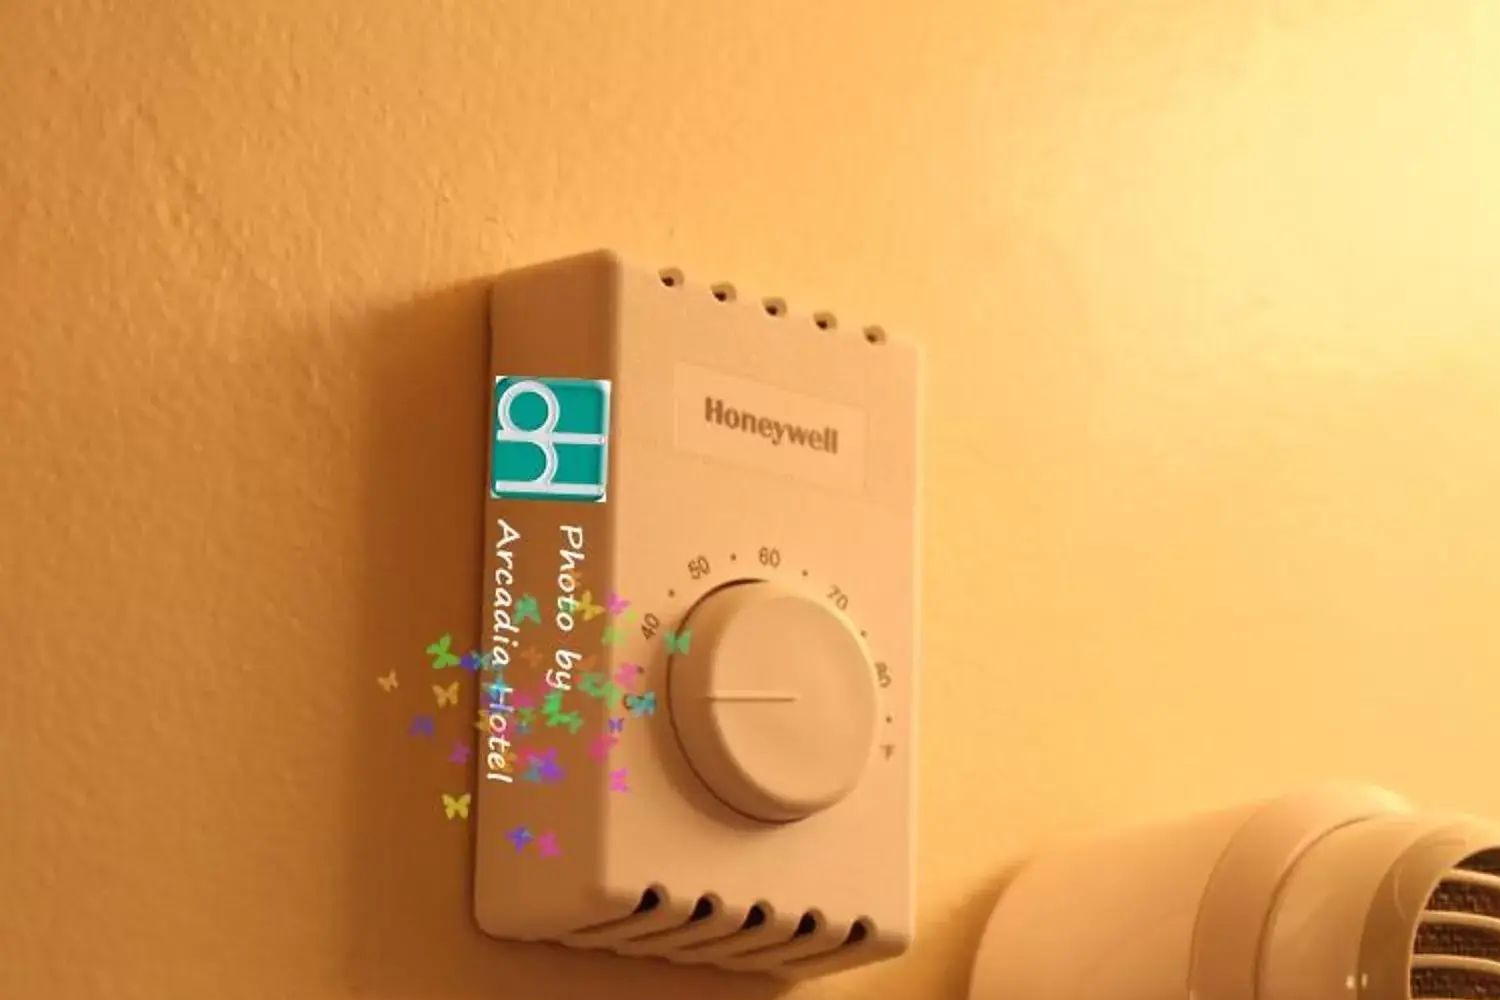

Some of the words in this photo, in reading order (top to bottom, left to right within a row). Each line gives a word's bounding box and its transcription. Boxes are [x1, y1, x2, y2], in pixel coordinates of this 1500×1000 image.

[705, 396, 838, 454] Honeywell
[687, 555, 711, 580] 50
[758, 546, 781, 568] 60
[826, 585, 850, 611] 70
[640, 613, 661, 640] 40
